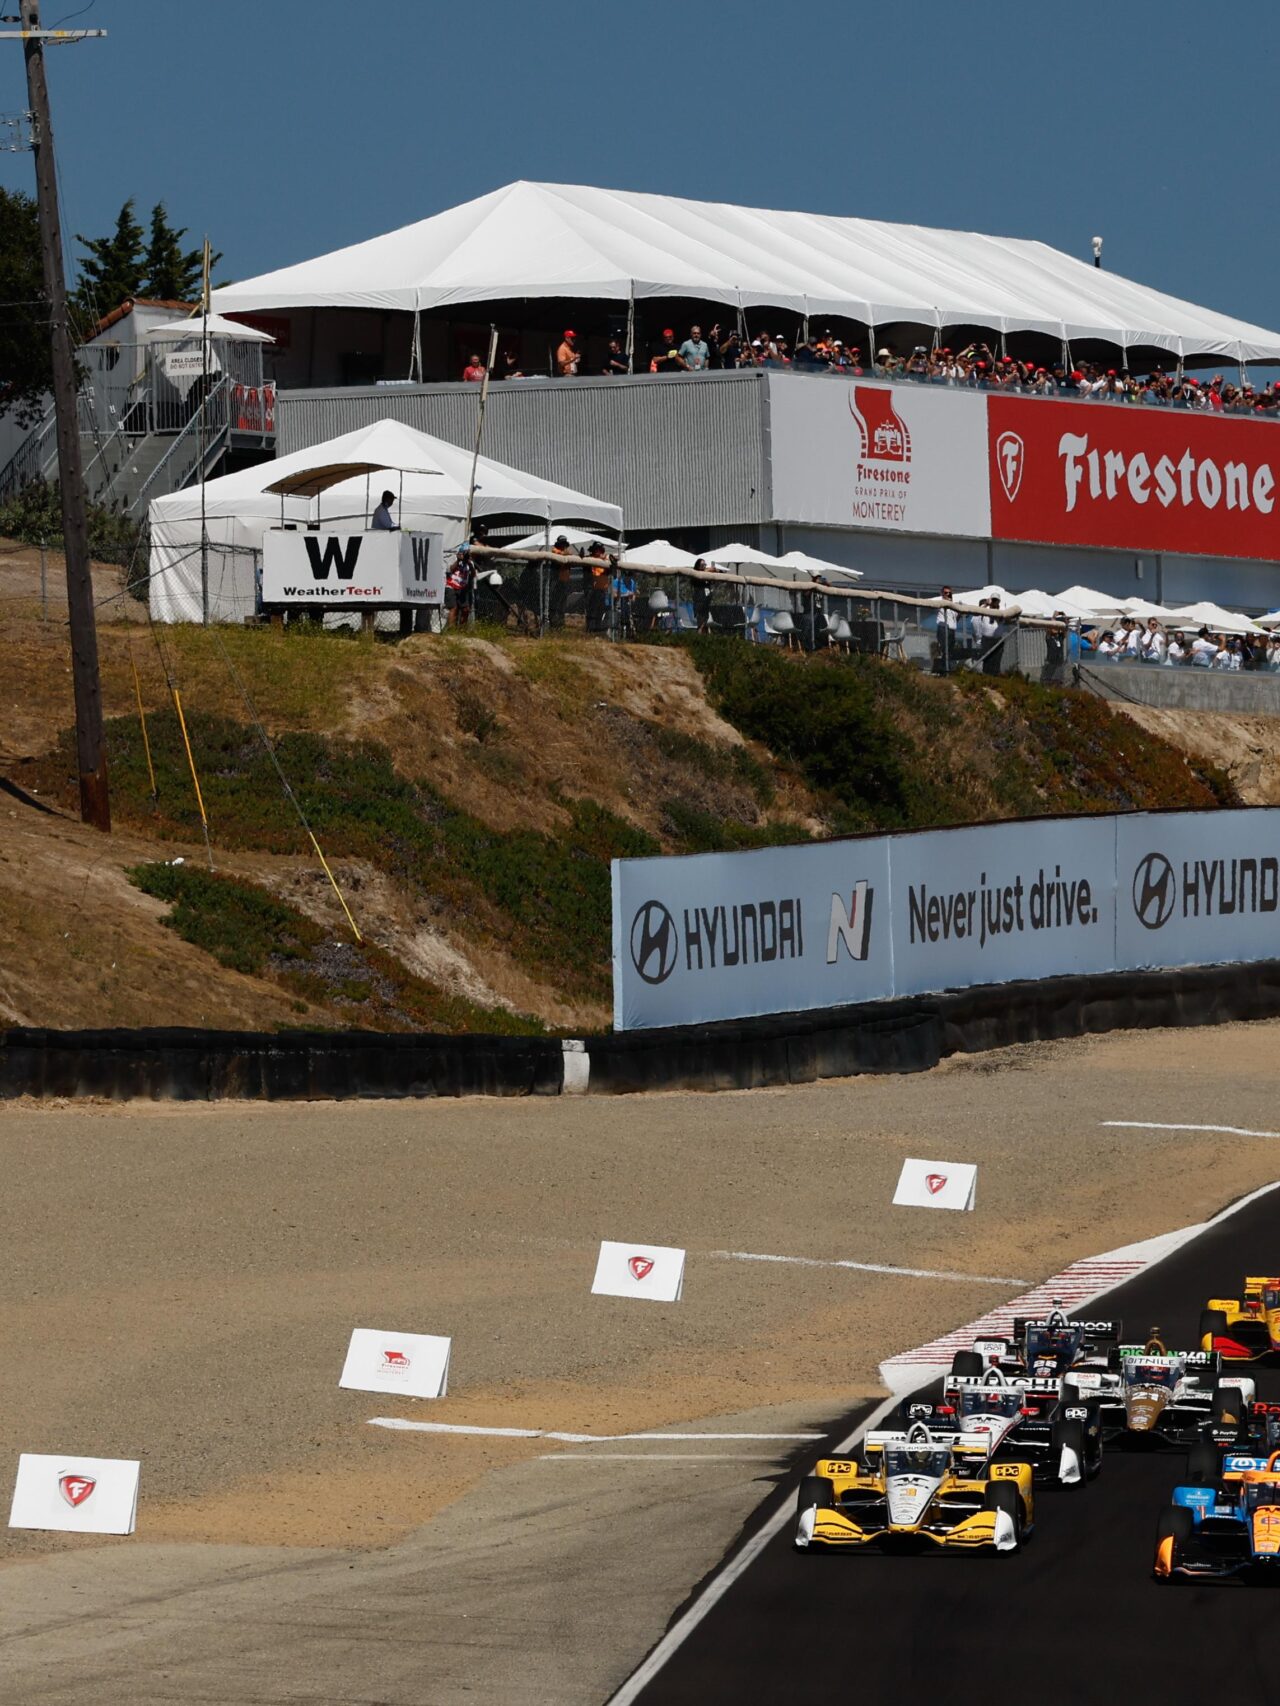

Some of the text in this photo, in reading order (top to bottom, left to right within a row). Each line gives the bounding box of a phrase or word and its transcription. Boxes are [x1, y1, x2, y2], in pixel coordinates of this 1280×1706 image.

[857, 464, 911, 484] Firestone
[1058, 432, 1275, 514] Firestone
[854, 486, 907, 499] GRAND PRIX OF
[852, 501, 906, 521] MONTEREY
[303, 536, 363, 580] W
[412, 537, 430, 581] W
[283, 586, 381, 596] WeatherTech
[684, 898, 802, 970] HYUNDAI
[908, 884, 976, 944] Never
[979, 872, 1024, 949] just
[1030, 865, 1098, 930] drive.
[828, 1463, 851, 1474] PPG
[995, 1466, 1019, 1476] PPG
